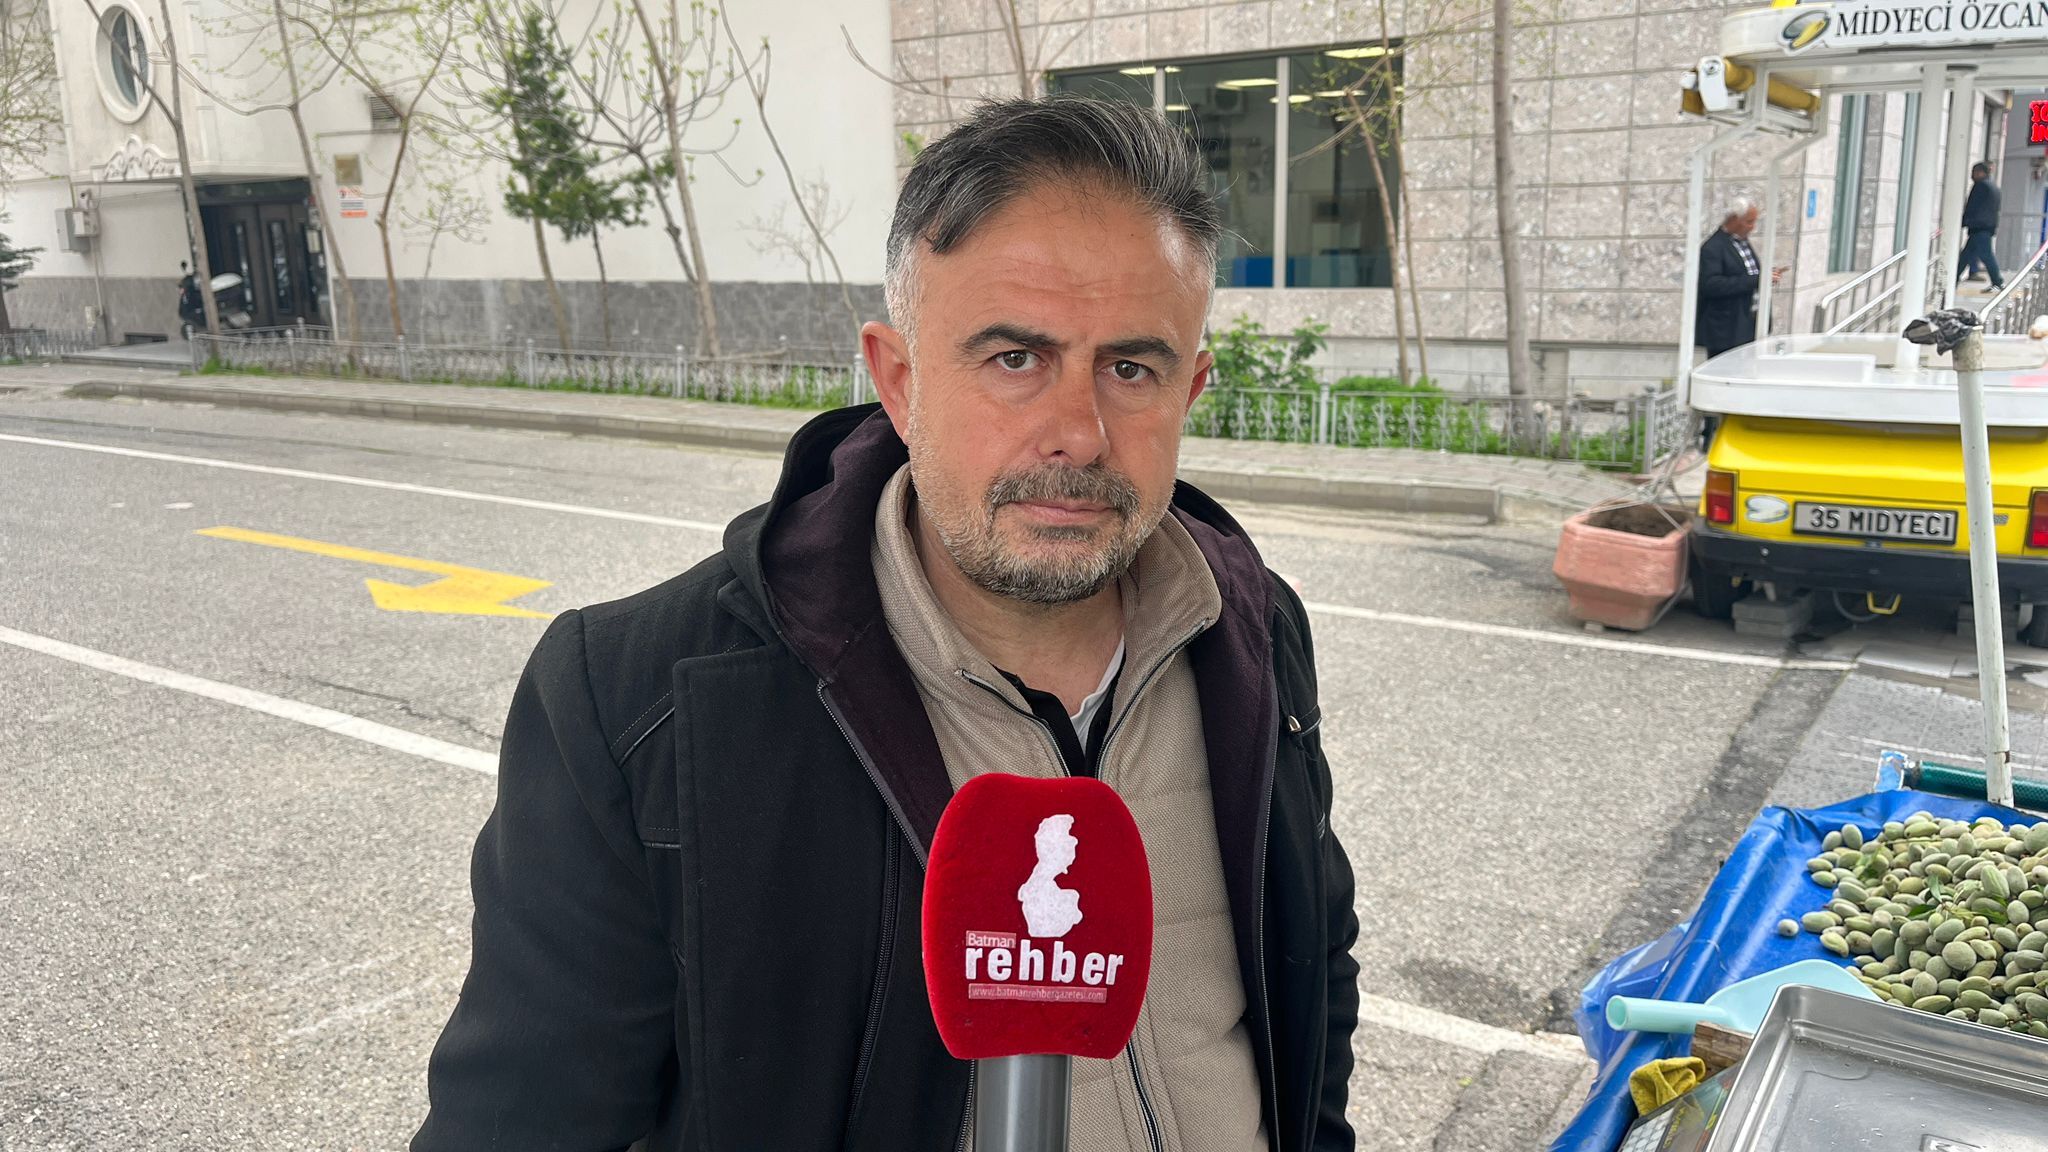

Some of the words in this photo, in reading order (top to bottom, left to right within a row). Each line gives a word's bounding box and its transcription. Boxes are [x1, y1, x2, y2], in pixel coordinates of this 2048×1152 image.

[1835, 0, 1953, 37] MİDYECİ
[1810, 506, 1840, 529] 35
[1849, 510, 1951, 537] MIDYECI
[968, 932, 1015, 949] Batman
[965, 939, 1124, 986] rehber
[972, 986, 1104, 1001] www.batmanrehbergazetesi.com
